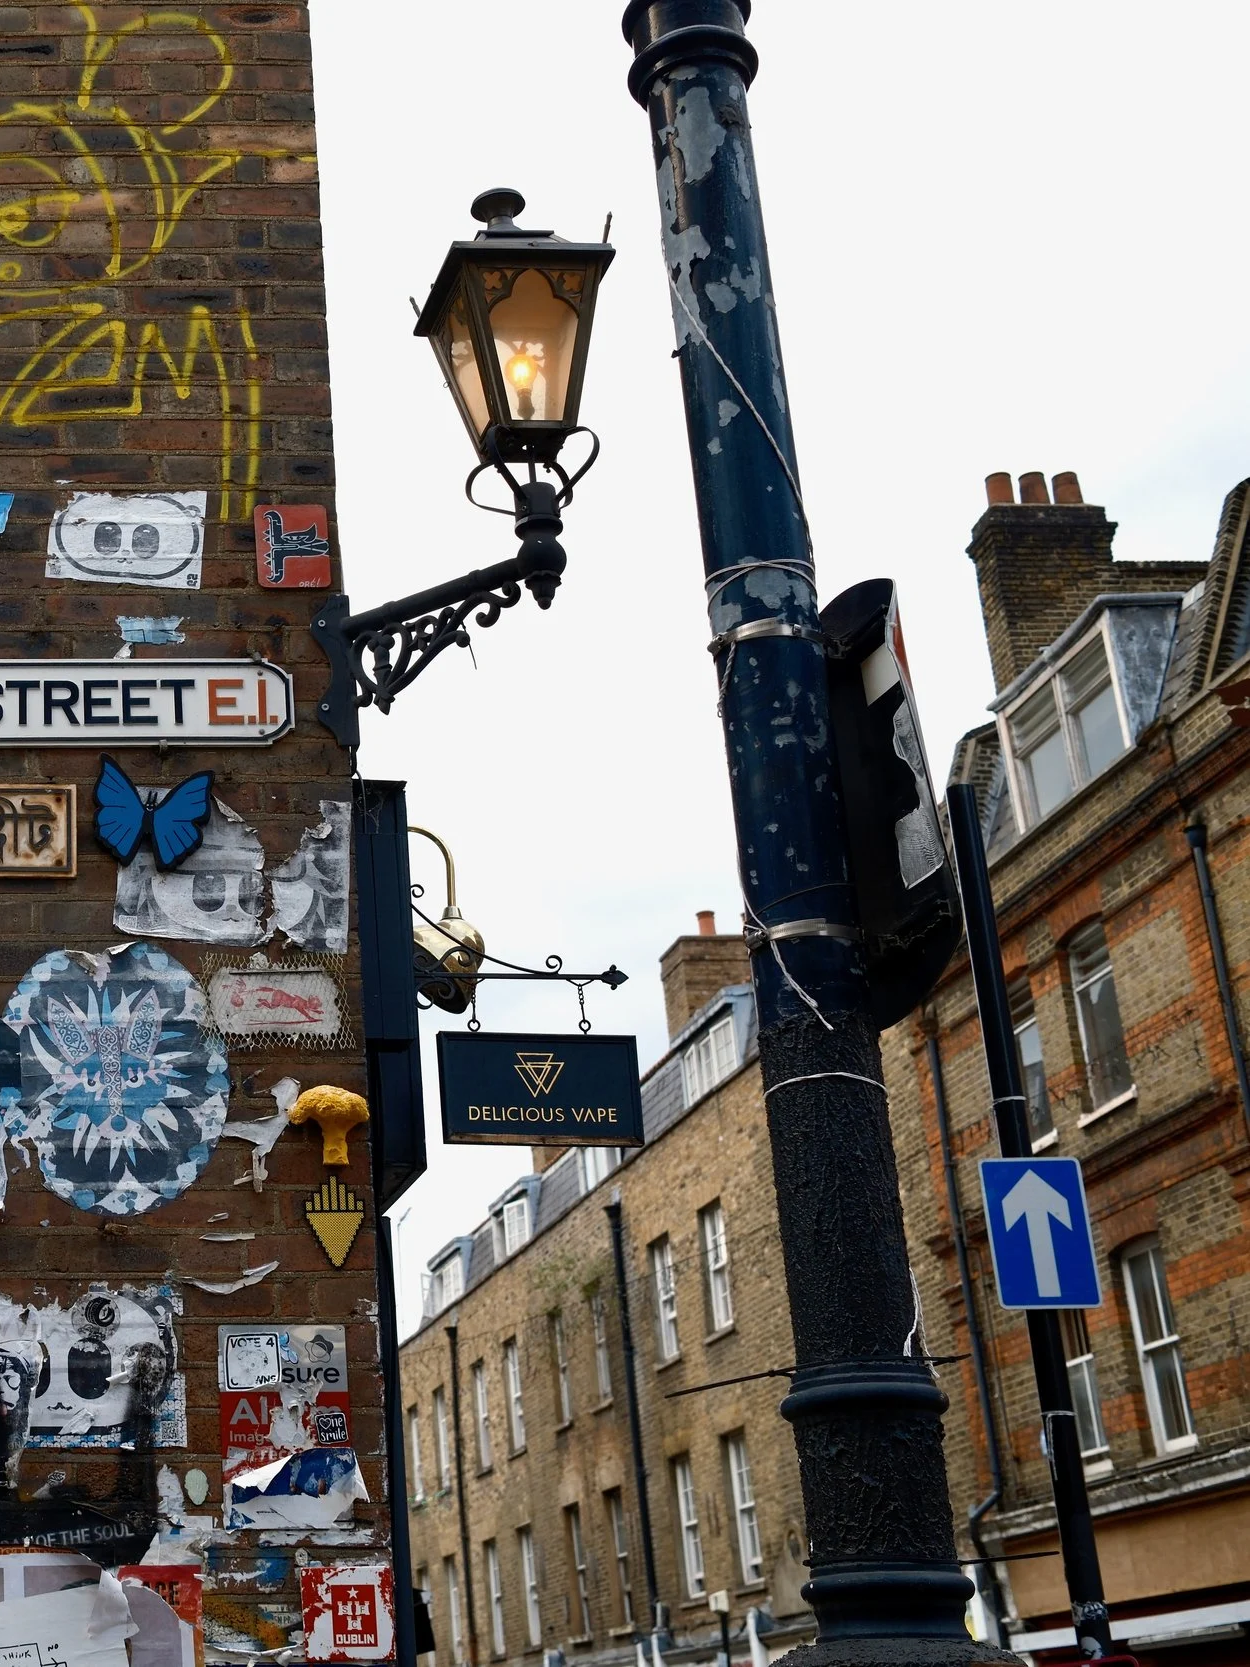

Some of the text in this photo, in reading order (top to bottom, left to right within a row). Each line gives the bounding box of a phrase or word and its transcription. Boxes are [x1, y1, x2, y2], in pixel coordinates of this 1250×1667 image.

[468, 1105, 618, 1123] DELICIOUS VAPE
[266, 1338, 274, 1347] 4
[282, 1367, 340, 1383] sure
[230, 1431, 265, 1444] Imag
[321, 1429, 346, 1442] smile
[60, 1529, 90, 1545] THE
[95, 1523, 135, 1541] SOUL
[336, 1634, 374, 1644] DUBLIN
[48, 1643, 59, 1652] NO
